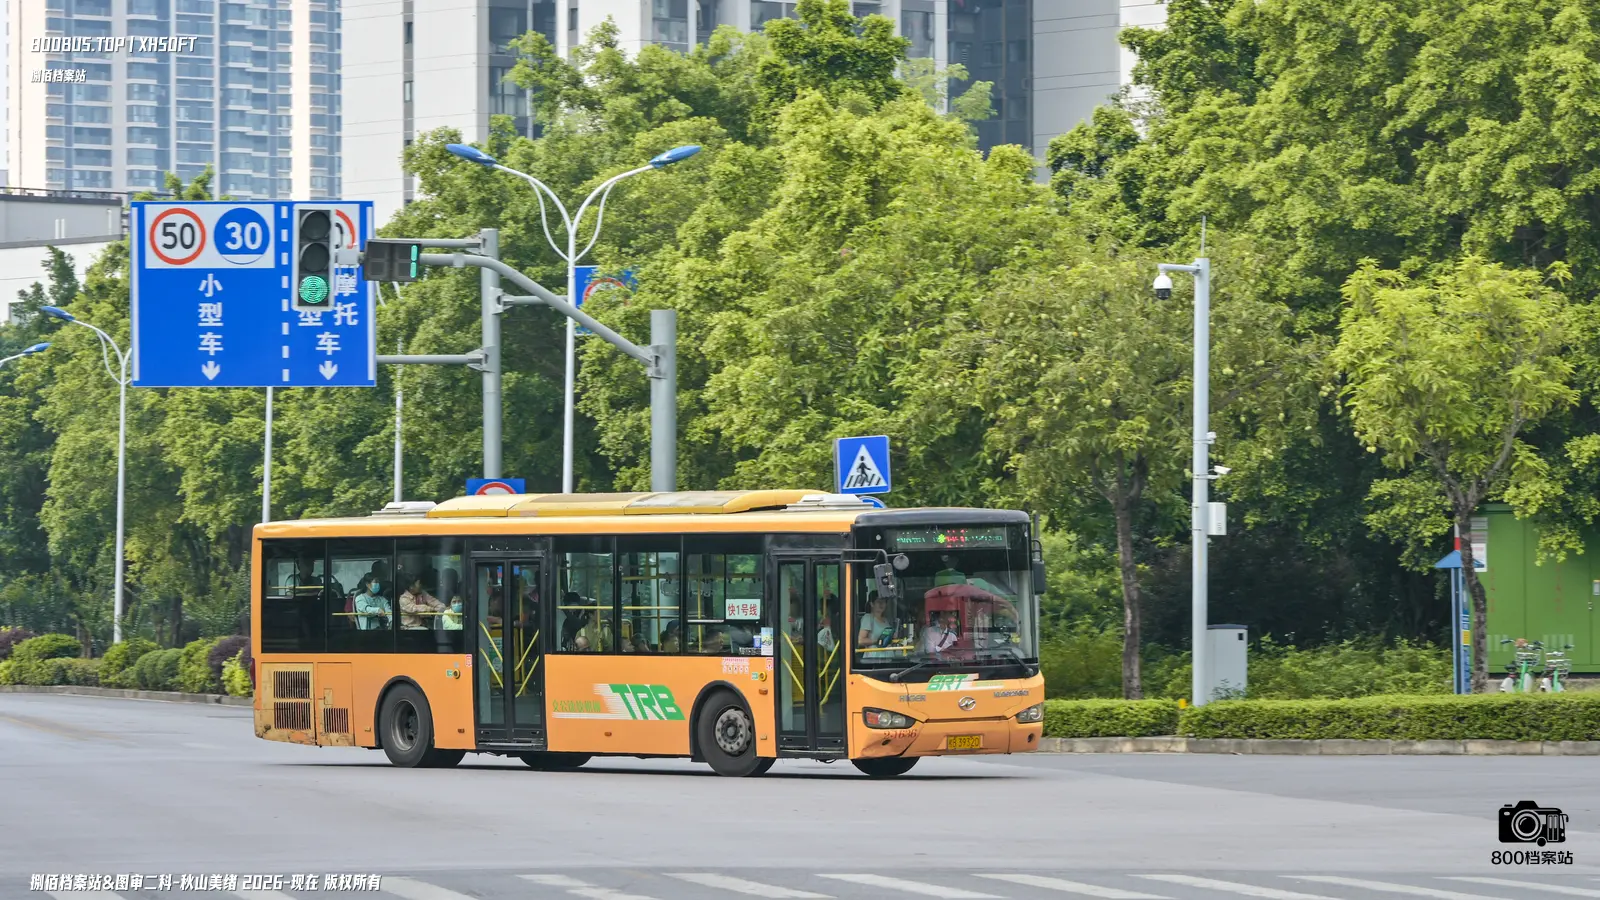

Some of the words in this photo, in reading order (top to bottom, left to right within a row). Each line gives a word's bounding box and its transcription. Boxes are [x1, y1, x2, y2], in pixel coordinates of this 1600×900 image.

[162, 222, 195, 250] 50
[225, 221, 263, 250] 30
[198, 273, 224, 356] 小型车
[727, 603, 758, 617] 快1号线
[926, 675, 969, 691] BRT
[608, 683, 686, 721] TRB
